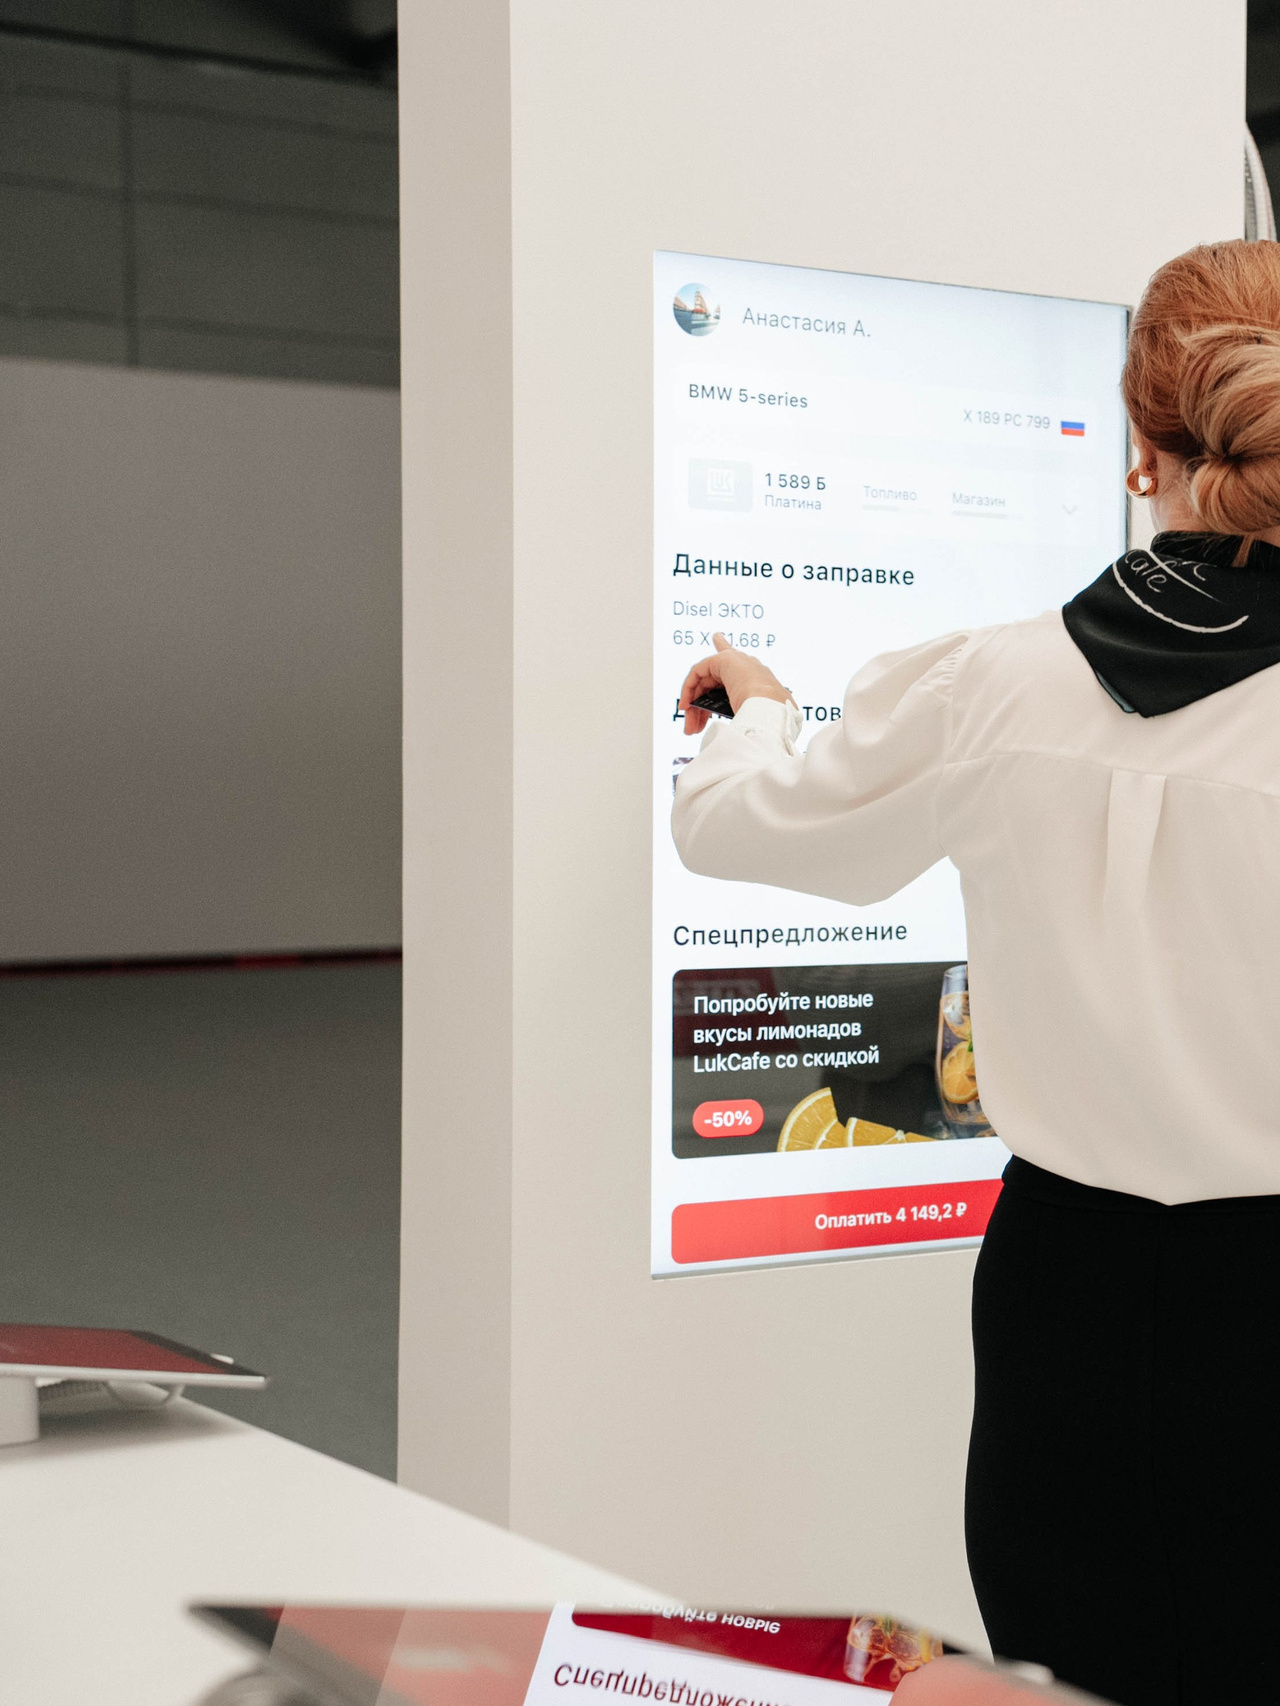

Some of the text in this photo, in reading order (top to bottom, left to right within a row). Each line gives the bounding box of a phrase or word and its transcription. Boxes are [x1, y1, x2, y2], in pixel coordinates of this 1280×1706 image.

[742, 307, 872, 338] Анастасия А.
[688, 384, 809, 408] BMW 5-series
[976, 410, 1001, 426] 189
[1026, 414, 1051, 430] 799
[764, 473, 772, 488] 1
[778, 474, 812, 490] 589
[764, 494, 823, 511] Платина
[863, 485, 918, 502] Топливо
[952, 492, 1006, 508] Магазин
[673, 553, 915, 587] Данные о заправке
[673, 600, 765, 620] Disel ЭКТО
[673, 630, 694, 646] 65
[719, 632, 760, 648] 1.68
[673, 923, 908, 948] Спецпредложение
[693, 991, 874, 1017] Попробуйте новые
[693, 1020, 862, 1047] вкусы лимонадов
[693, 1045, 880, 1073] LukCafe со скидкой
[704, 1110, 752, 1128] -50%
[815, 1208, 892, 1230] Оплатить
[896, 1206, 907, 1222] 4
[910, 1202, 953, 1223] 149,2
